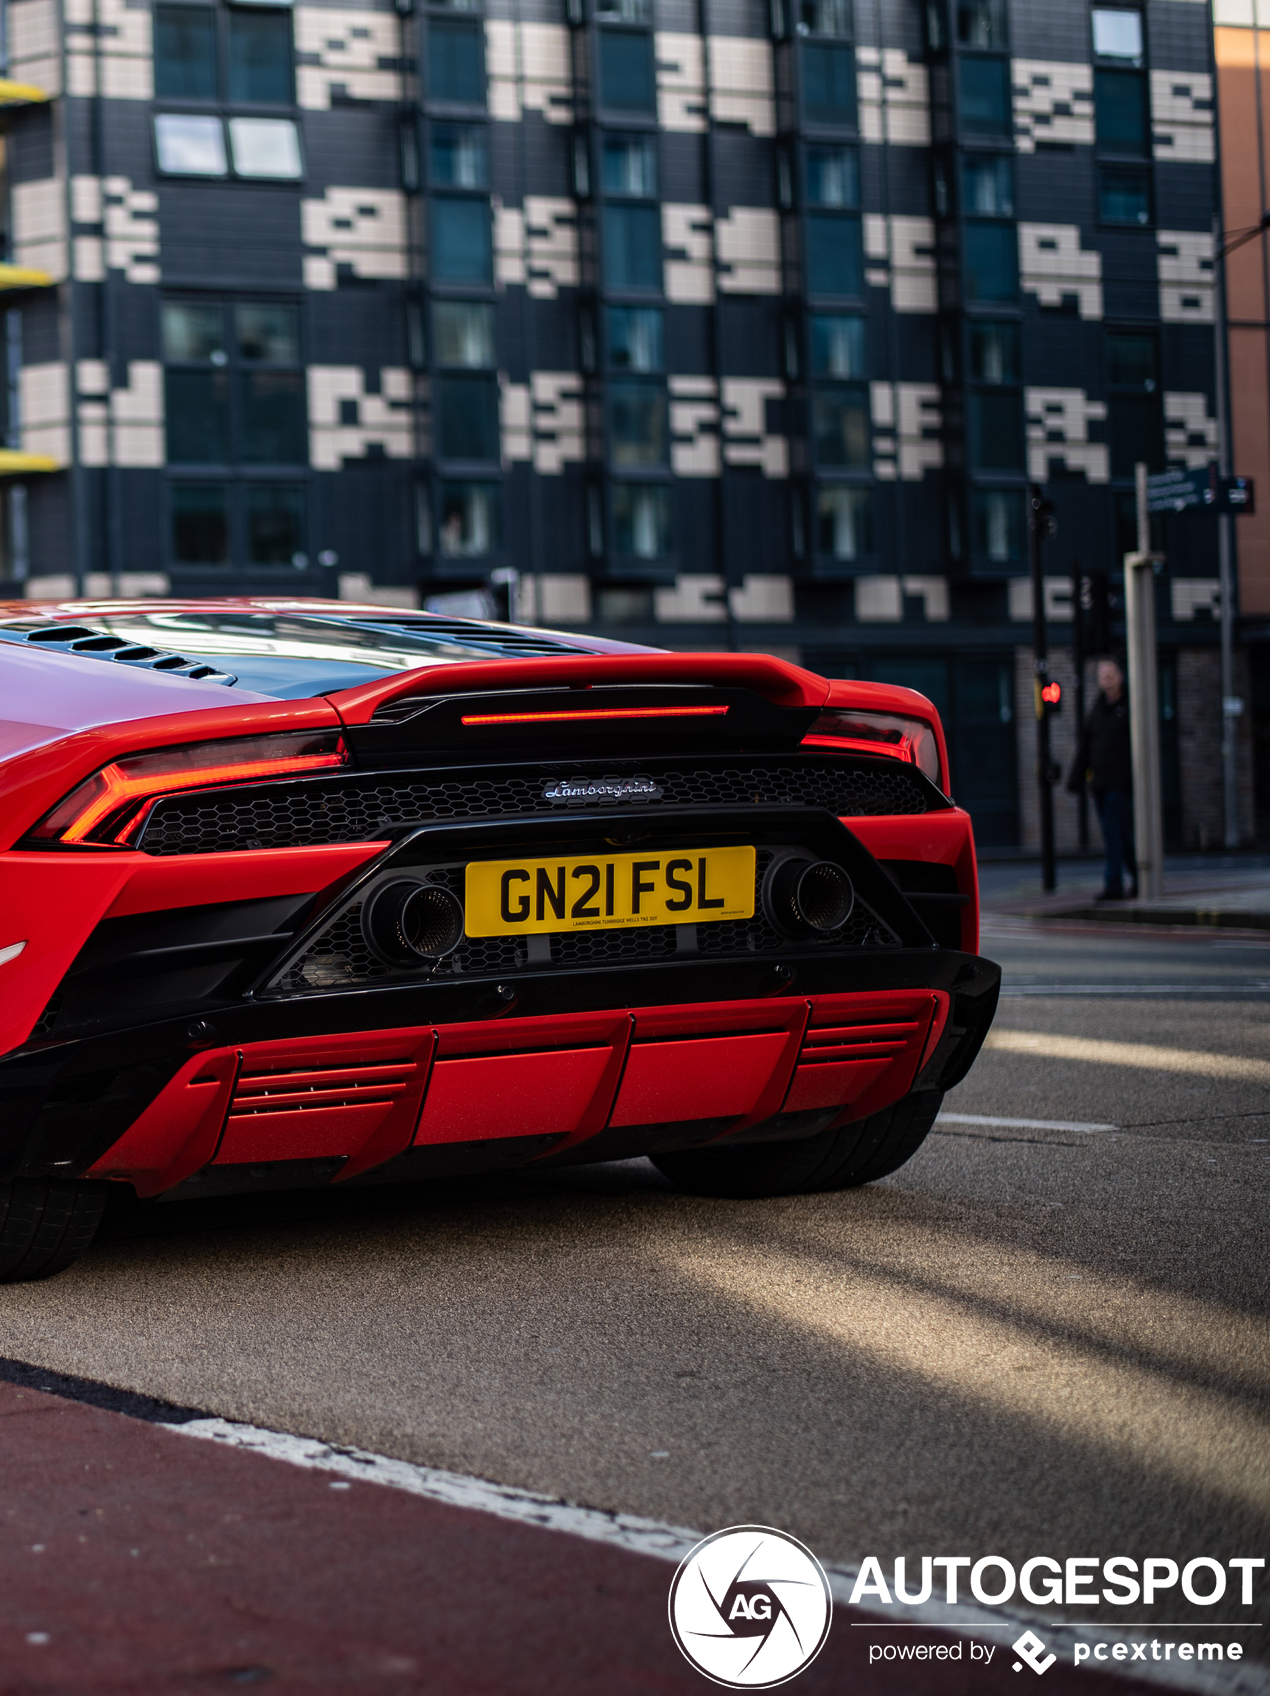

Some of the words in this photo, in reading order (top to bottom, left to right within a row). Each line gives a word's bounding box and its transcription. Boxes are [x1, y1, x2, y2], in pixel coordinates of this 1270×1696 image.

[545, 781, 656, 797] Lamborghini
[500, 863, 614, 923] GN21
[632, 857, 724, 914] FSL
